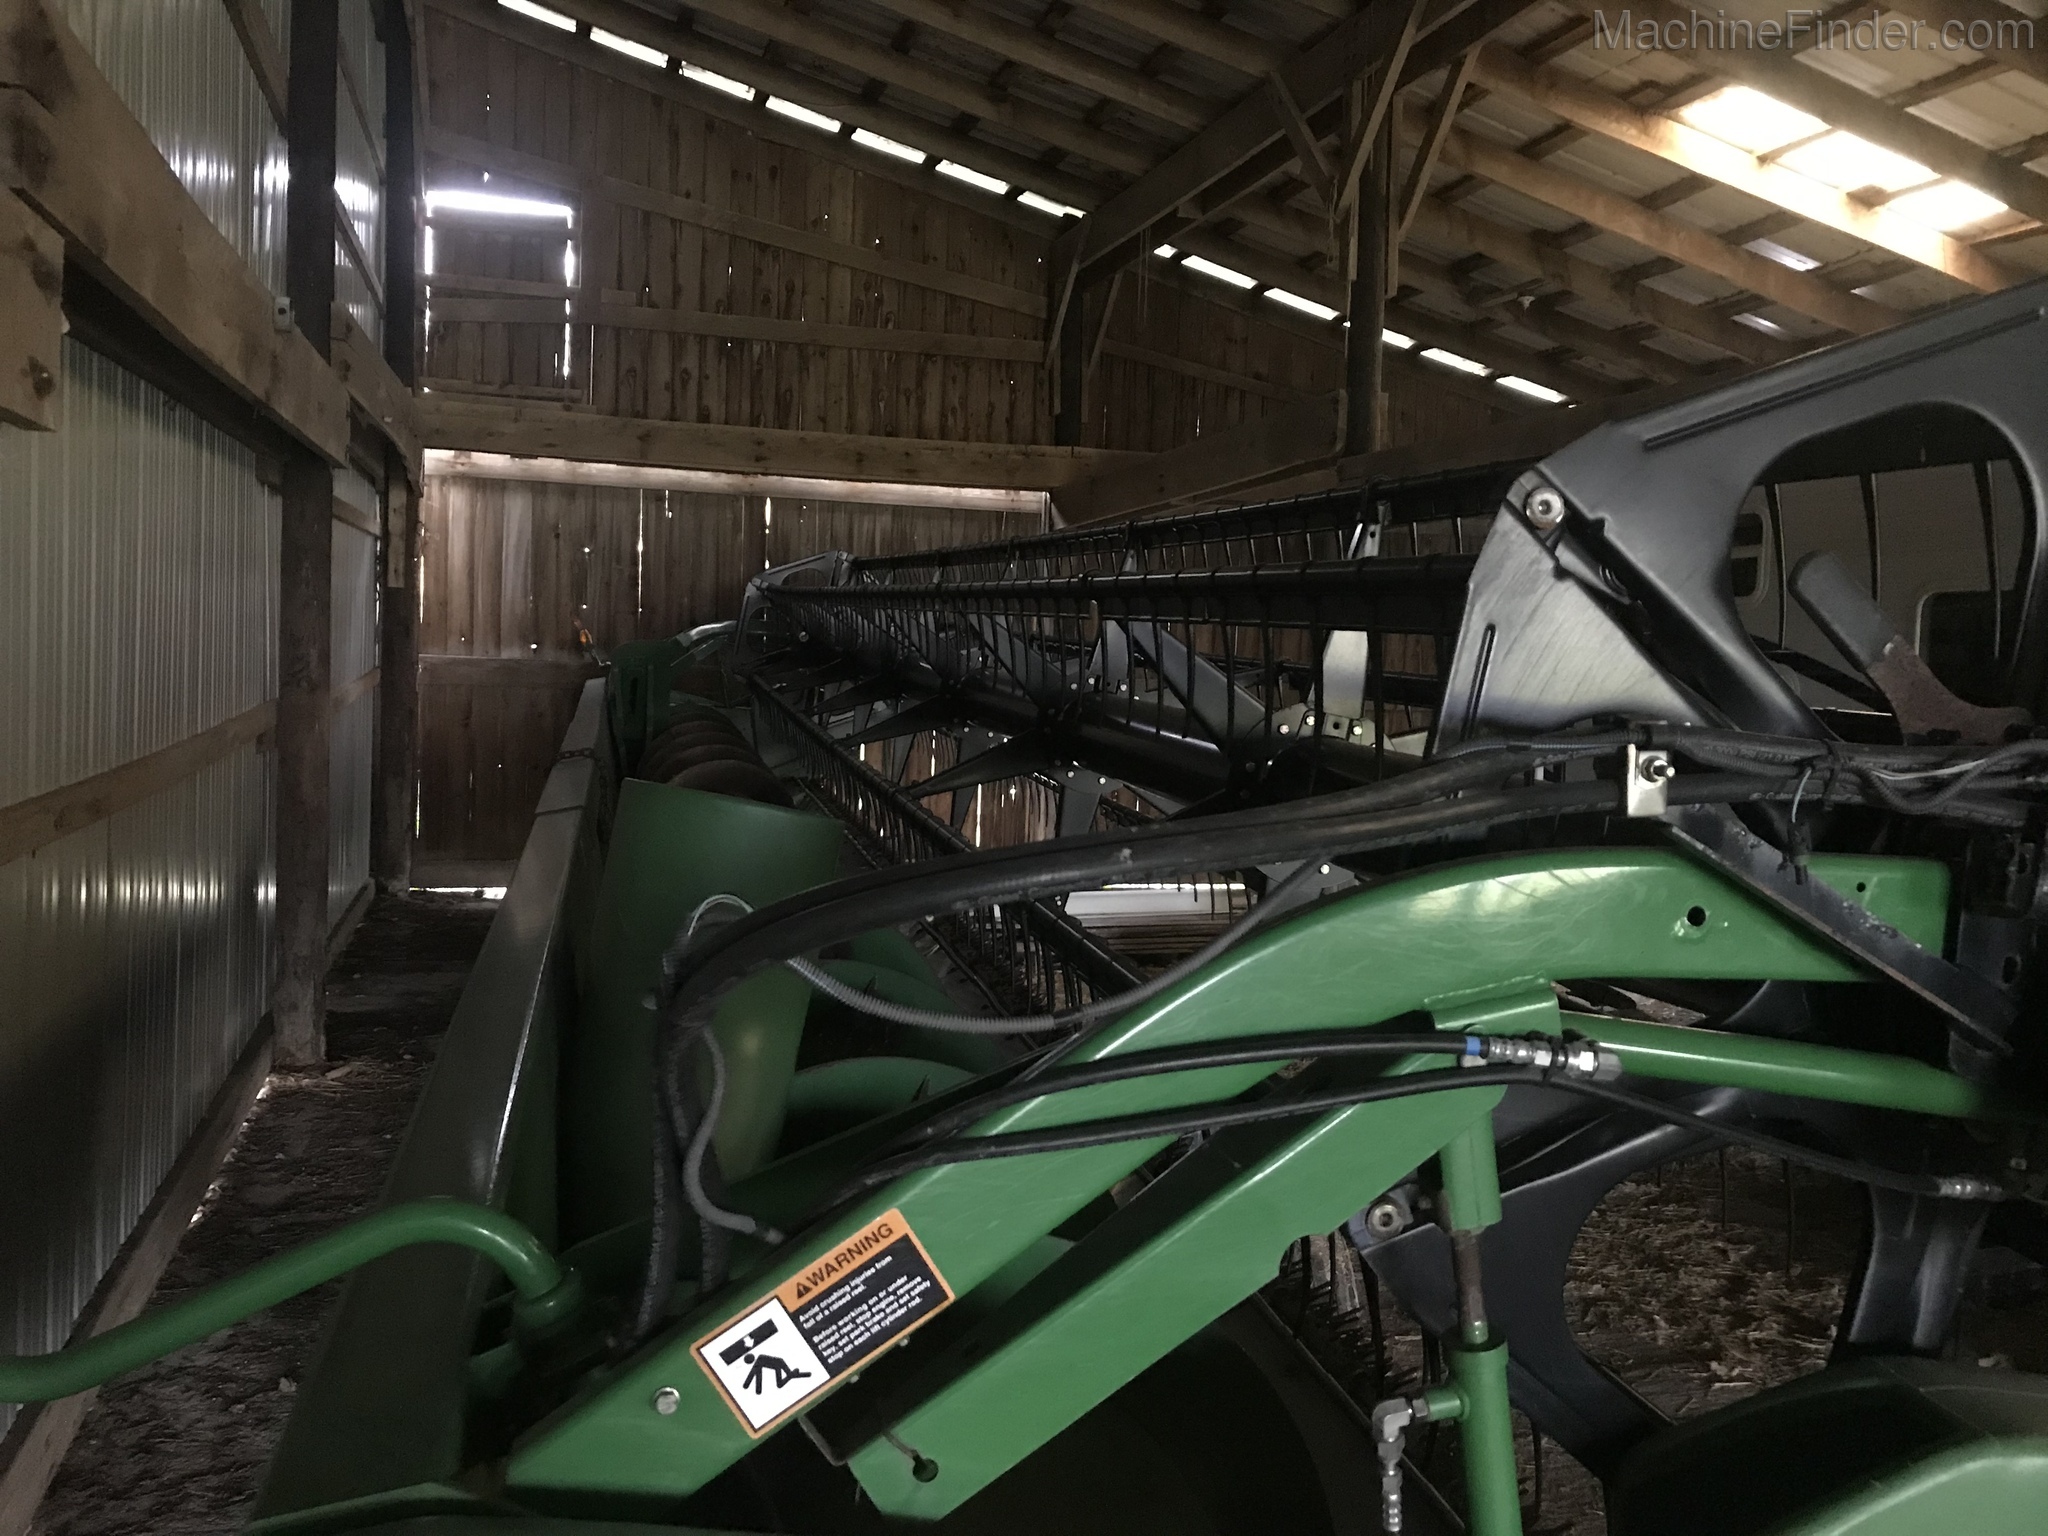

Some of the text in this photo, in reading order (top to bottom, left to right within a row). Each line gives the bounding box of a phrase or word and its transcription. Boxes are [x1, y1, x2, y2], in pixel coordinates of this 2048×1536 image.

[805, 1220, 894, 1290] WARNING
[798, 1304, 820, 1323] Avoid
[874, 1254, 893, 1270] from
[812, 1322, 838, 1343] Before
[836, 1302, 869, 1328] working
[886, 1274, 909, 1292] under
[848, 1323, 866, 1340] park
[864, 1310, 886, 1327] brake
[908, 1278, 932, 1298] safety
[855, 1310, 873, 1325] stop
[896, 1275, 923, 1296] remove
[827, 1349, 845, 1365] stop
[852, 1330, 871, 1346] each
[869, 1323, 881, 1334] lift
[879, 1304, 909, 1329] cylinder
